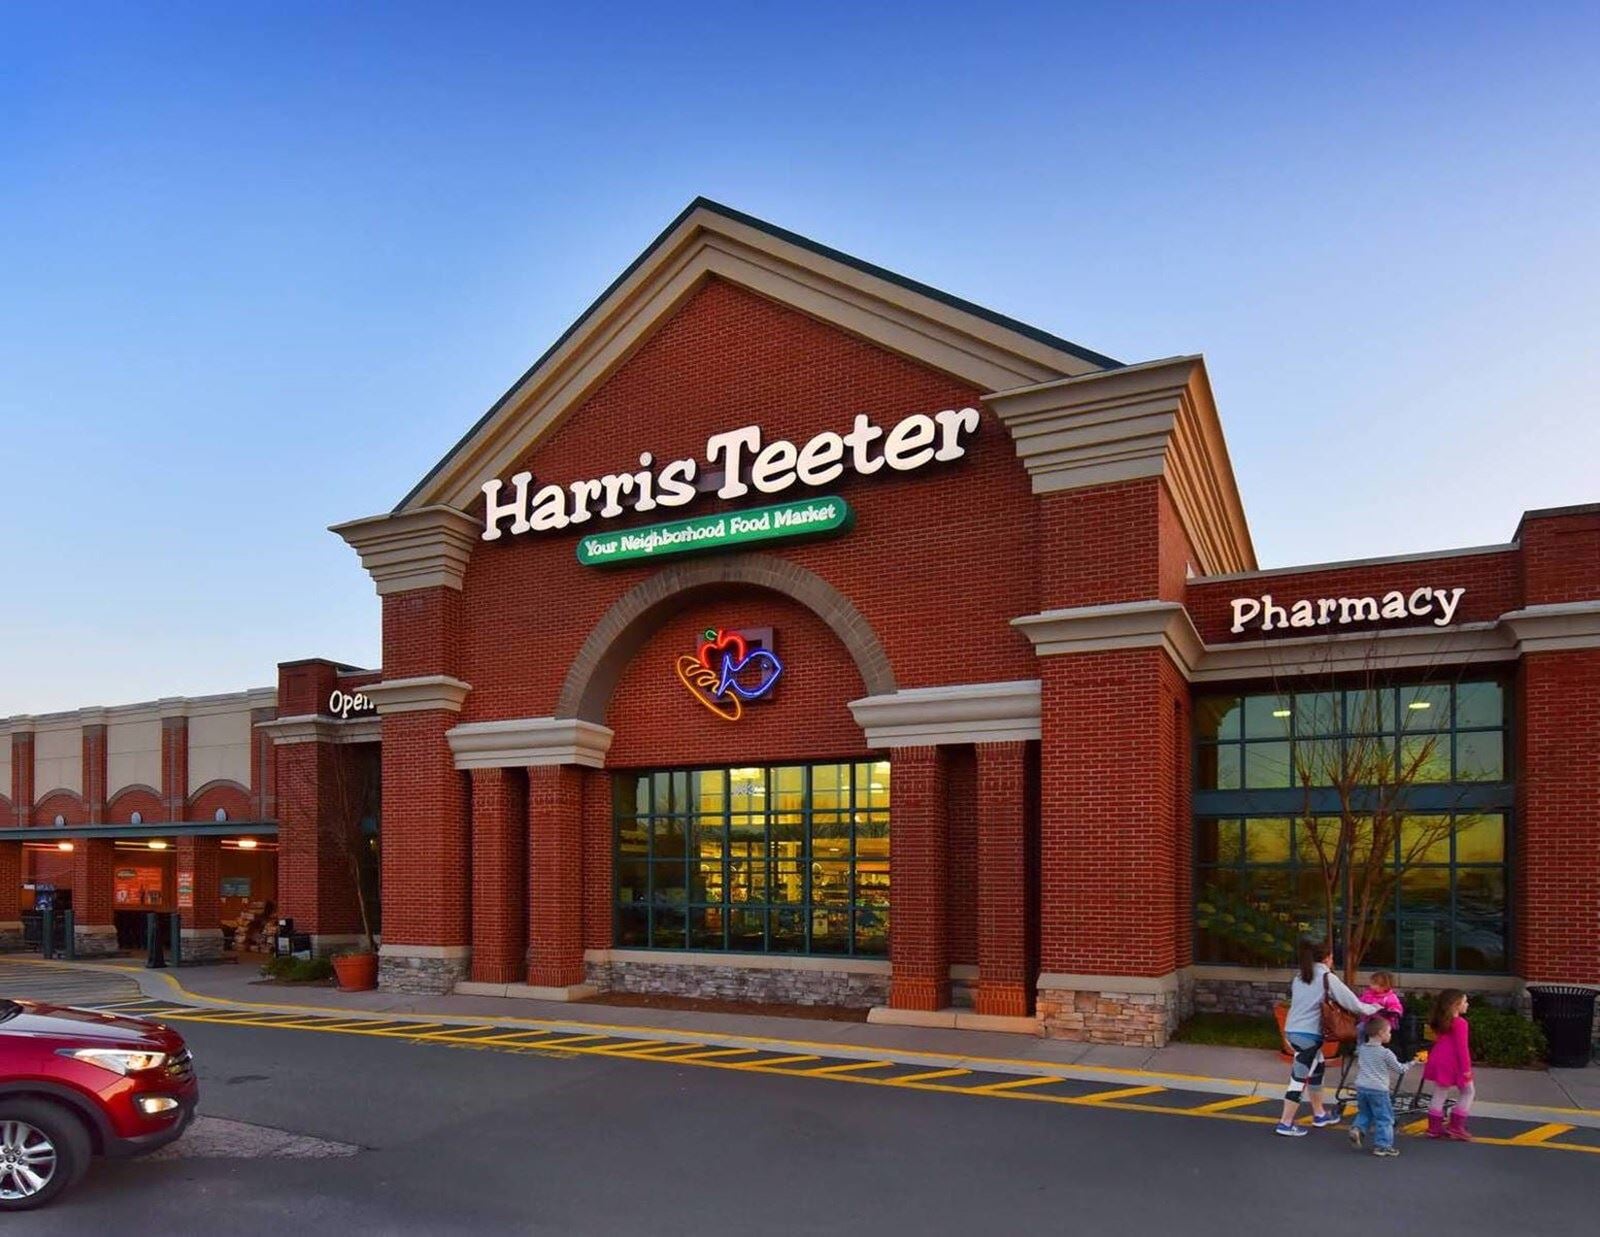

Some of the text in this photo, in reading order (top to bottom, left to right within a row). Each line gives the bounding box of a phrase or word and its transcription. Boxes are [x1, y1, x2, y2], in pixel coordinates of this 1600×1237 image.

[480, 407, 980, 541] Harris Teeter
[585, 504, 836, 556] Your Neighborhood Food Market
[1230, 586, 1466, 633] Pharmacy
